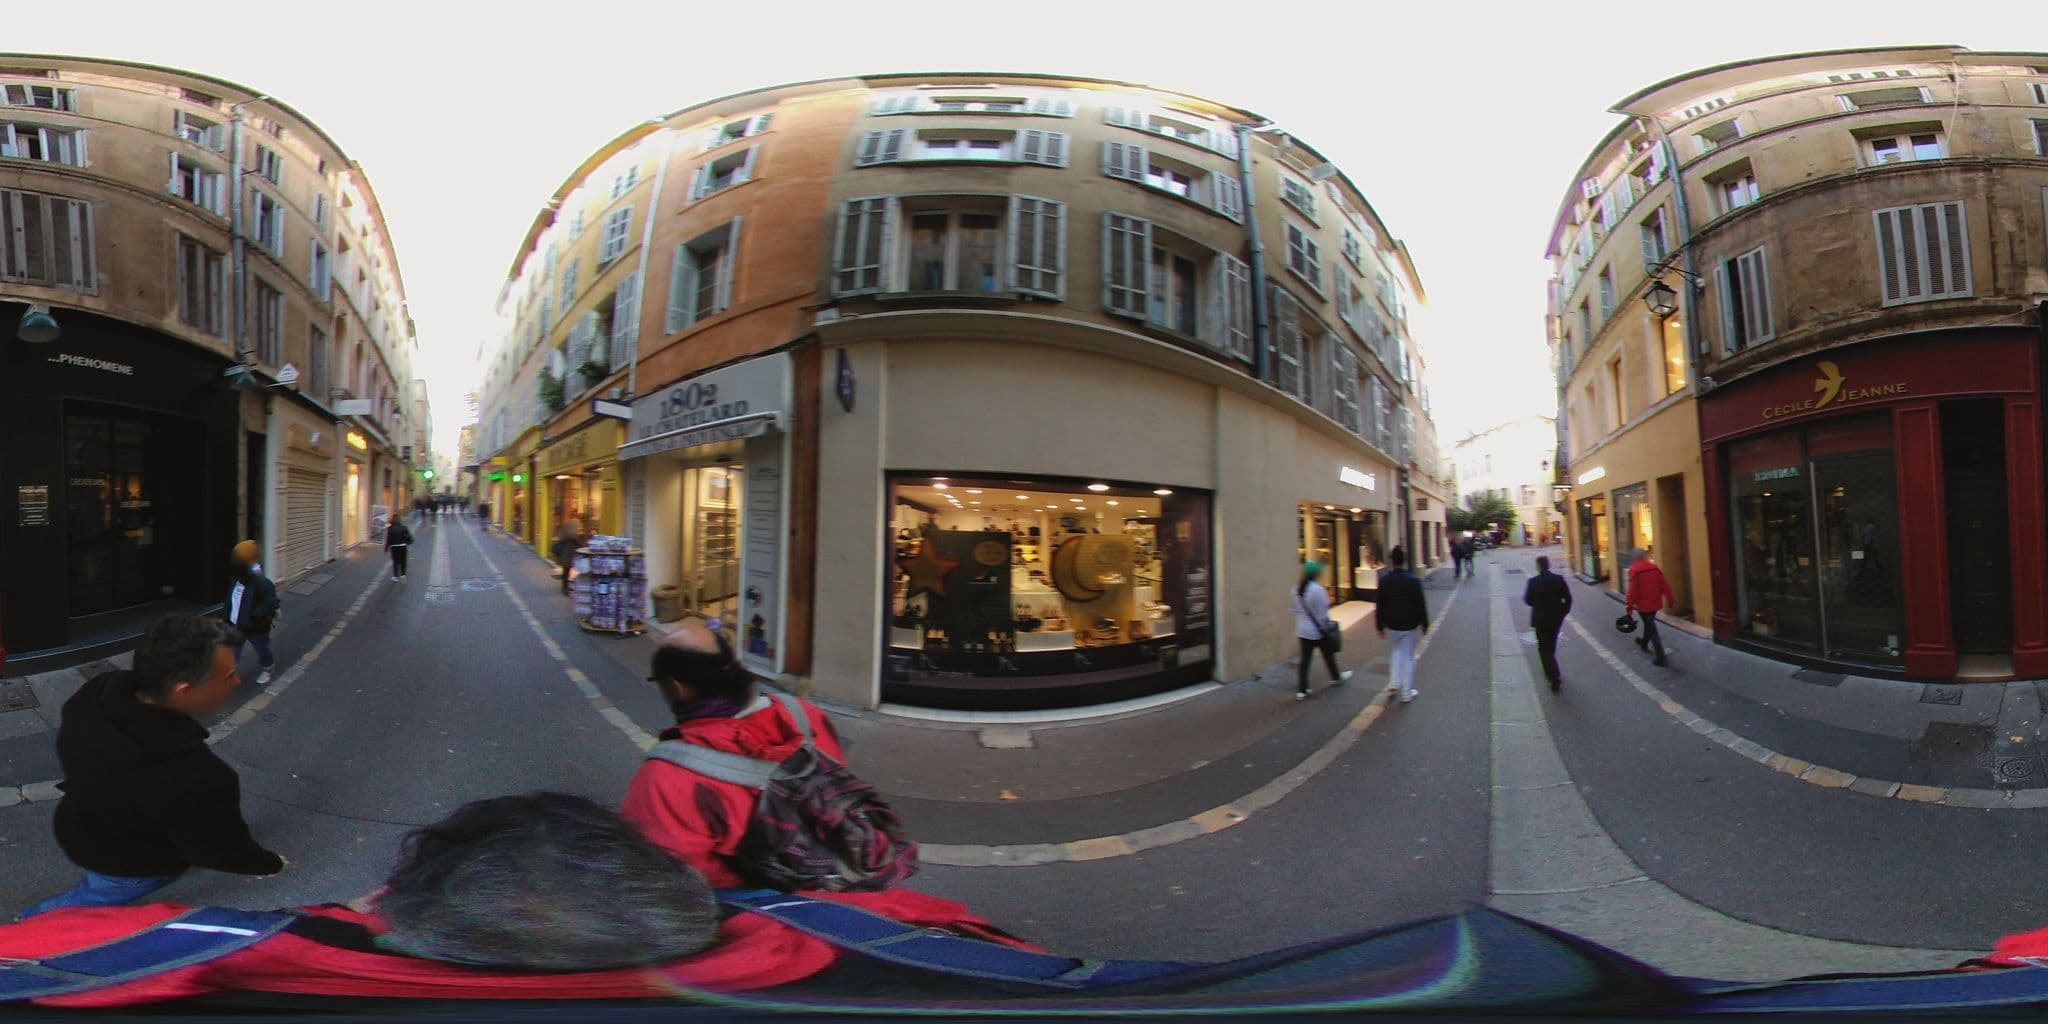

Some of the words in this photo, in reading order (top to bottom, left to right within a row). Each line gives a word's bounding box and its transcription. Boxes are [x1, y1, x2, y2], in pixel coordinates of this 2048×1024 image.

[660, 382, 718, 419] 1802
[1761, 399, 1814, 419] CECILE
[1837, 382, 1907, 402] JEANNE
